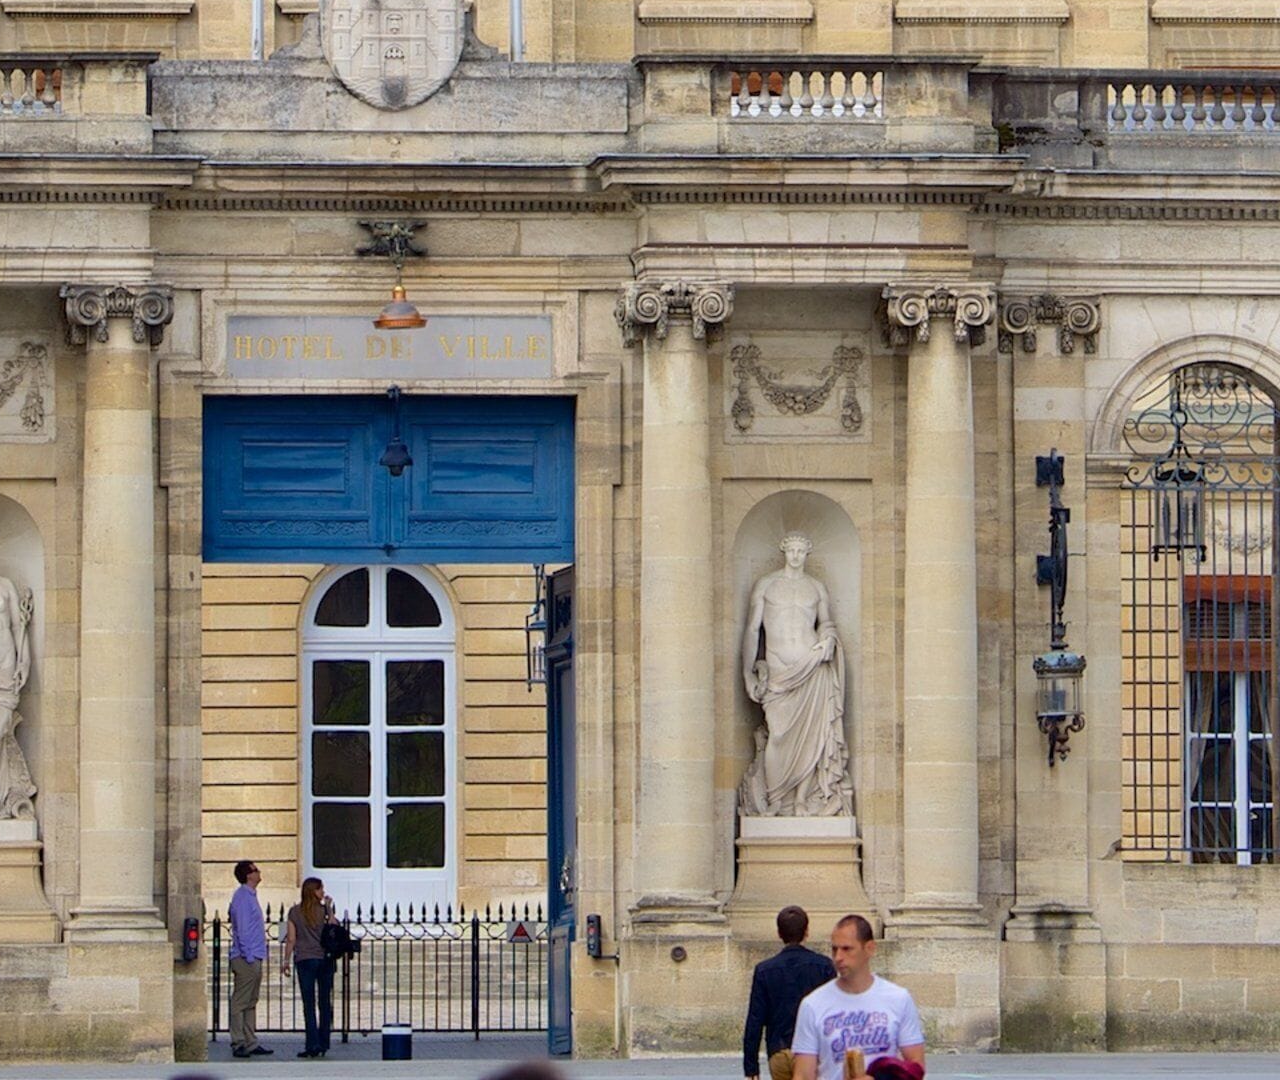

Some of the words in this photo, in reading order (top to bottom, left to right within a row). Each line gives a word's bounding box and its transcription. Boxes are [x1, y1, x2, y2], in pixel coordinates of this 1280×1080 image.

[233, 335, 345, 361] HOTEL
[365, 335, 414, 361] DE
[439, 335, 548, 361] VILLE
[823, 1010, 871, 1036] Teddy
[831, 1026, 890, 1052] Smith
